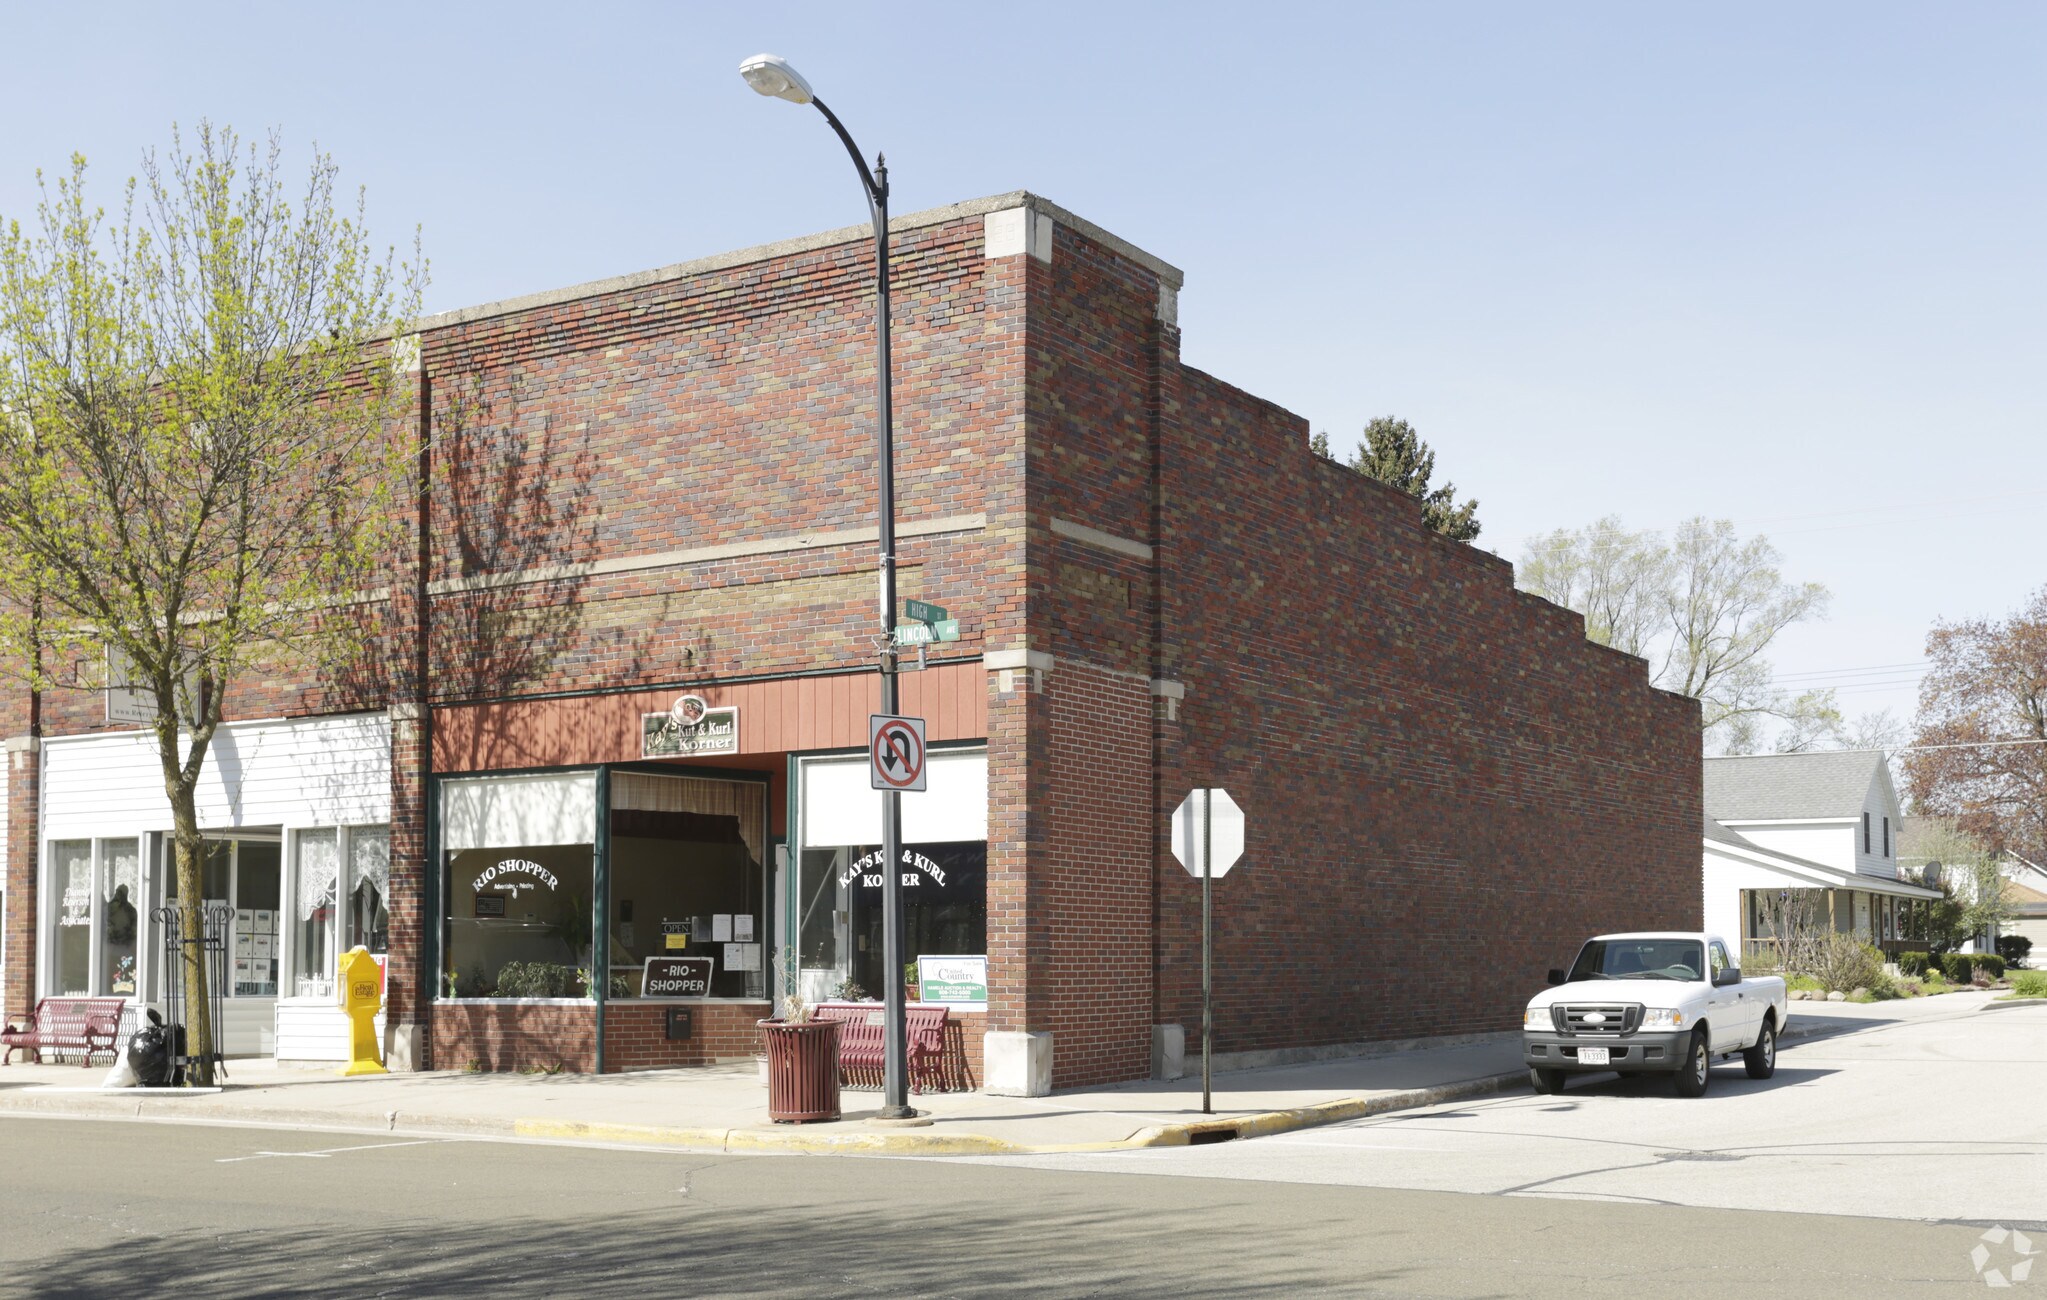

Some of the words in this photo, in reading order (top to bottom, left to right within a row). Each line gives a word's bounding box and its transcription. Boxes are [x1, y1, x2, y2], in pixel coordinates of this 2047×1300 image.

[911, 603, 928, 620] HIGH
[897, 624, 937, 643] LINCOLN
[946, 625, 956, 634] AVE
[646, 716, 678, 751] Kay's
[678, 725, 696, 738] Kut
[698, 723, 706, 736] &
[709, 721, 731, 736] Kurl
[678, 738, 733, 751] Korner
[472, 866, 497, 893] RIO
[498, 859, 558, 892] SHOPPER
[839, 854, 873, 890] KAY'S
[902, 849, 912, 864] &
[913, 852, 946, 887] KURL
[863, 873, 920, 888] KOER
[664, 924, 690, 933] OPEN
[938, 968, 974, 981] Country
[649, 980, 705, 992] SHOPPER
